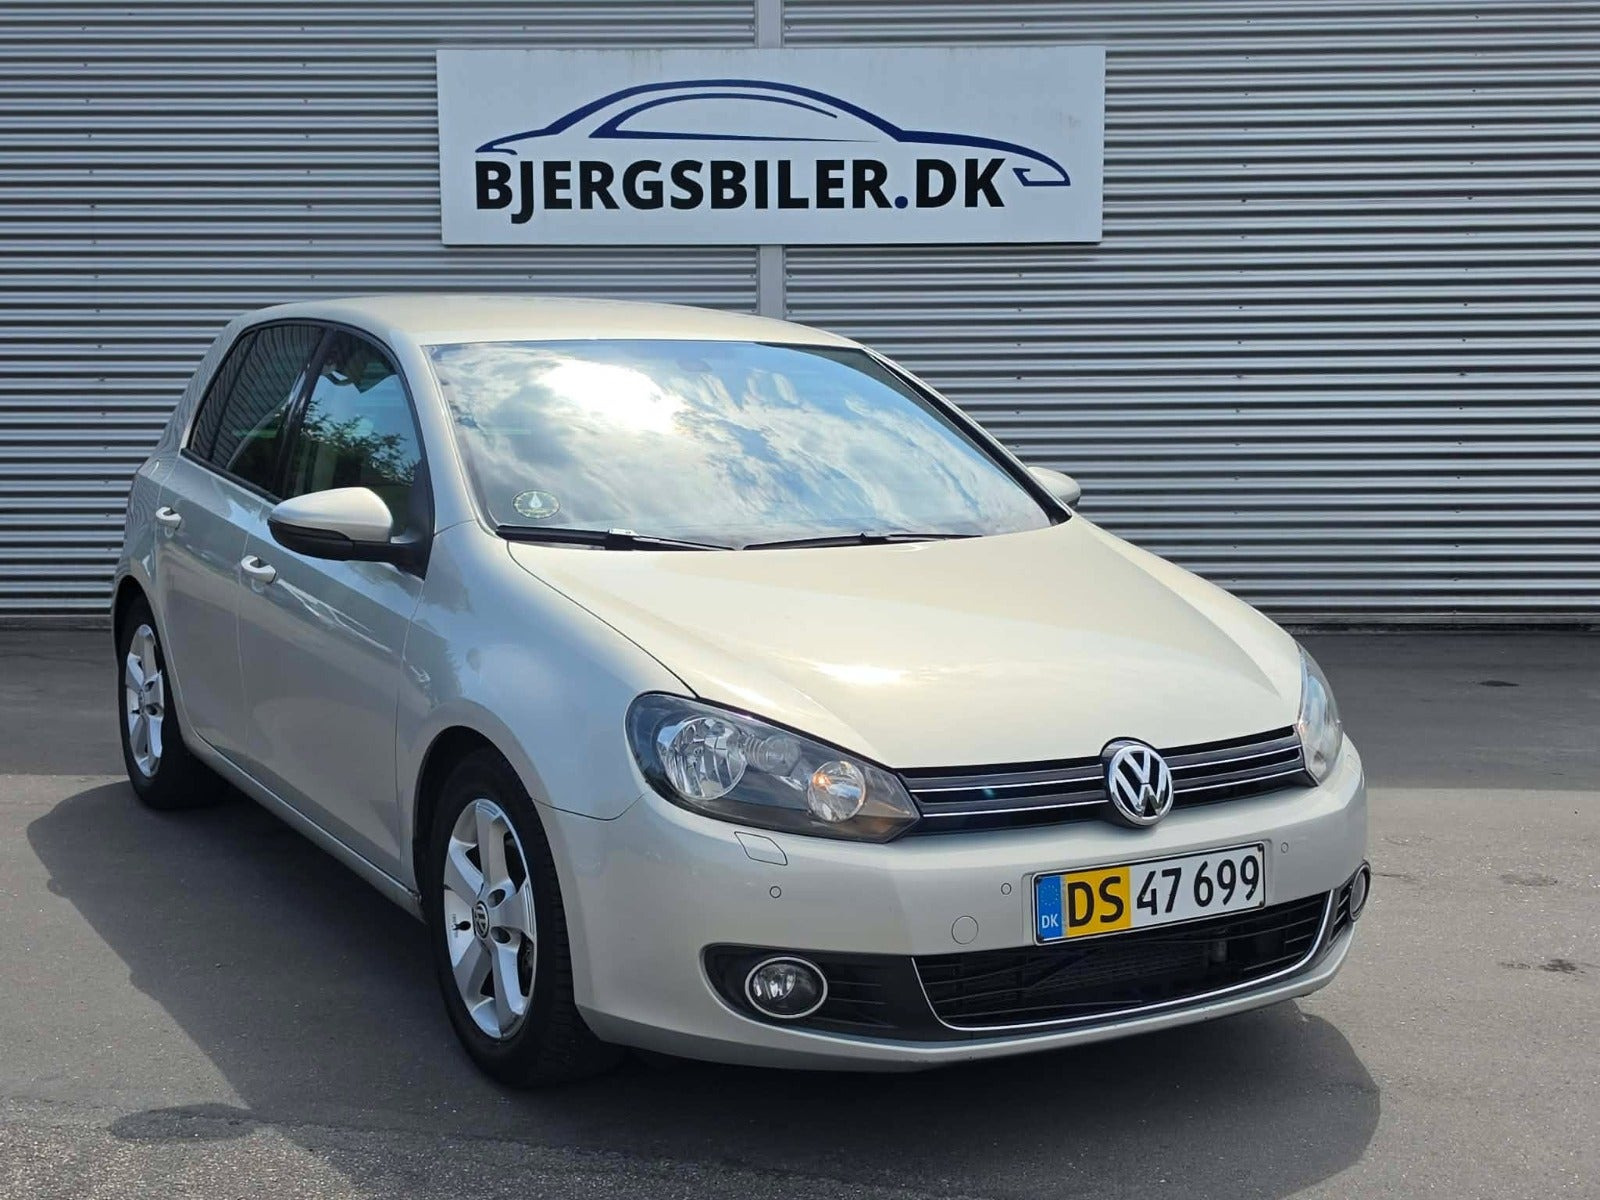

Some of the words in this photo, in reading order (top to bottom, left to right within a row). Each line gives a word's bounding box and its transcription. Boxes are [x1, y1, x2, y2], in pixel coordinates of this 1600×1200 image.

[476, 158, 1005, 223] BJERGSBILER.DK
[1111, 748, 1170, 819] VW
[1041, 914, 1059, 929] DK
[1067, 876, 1124, 927] DS
[1136, 867, 1182, 915] 47
[1193, 855, 1260, 907] 699
